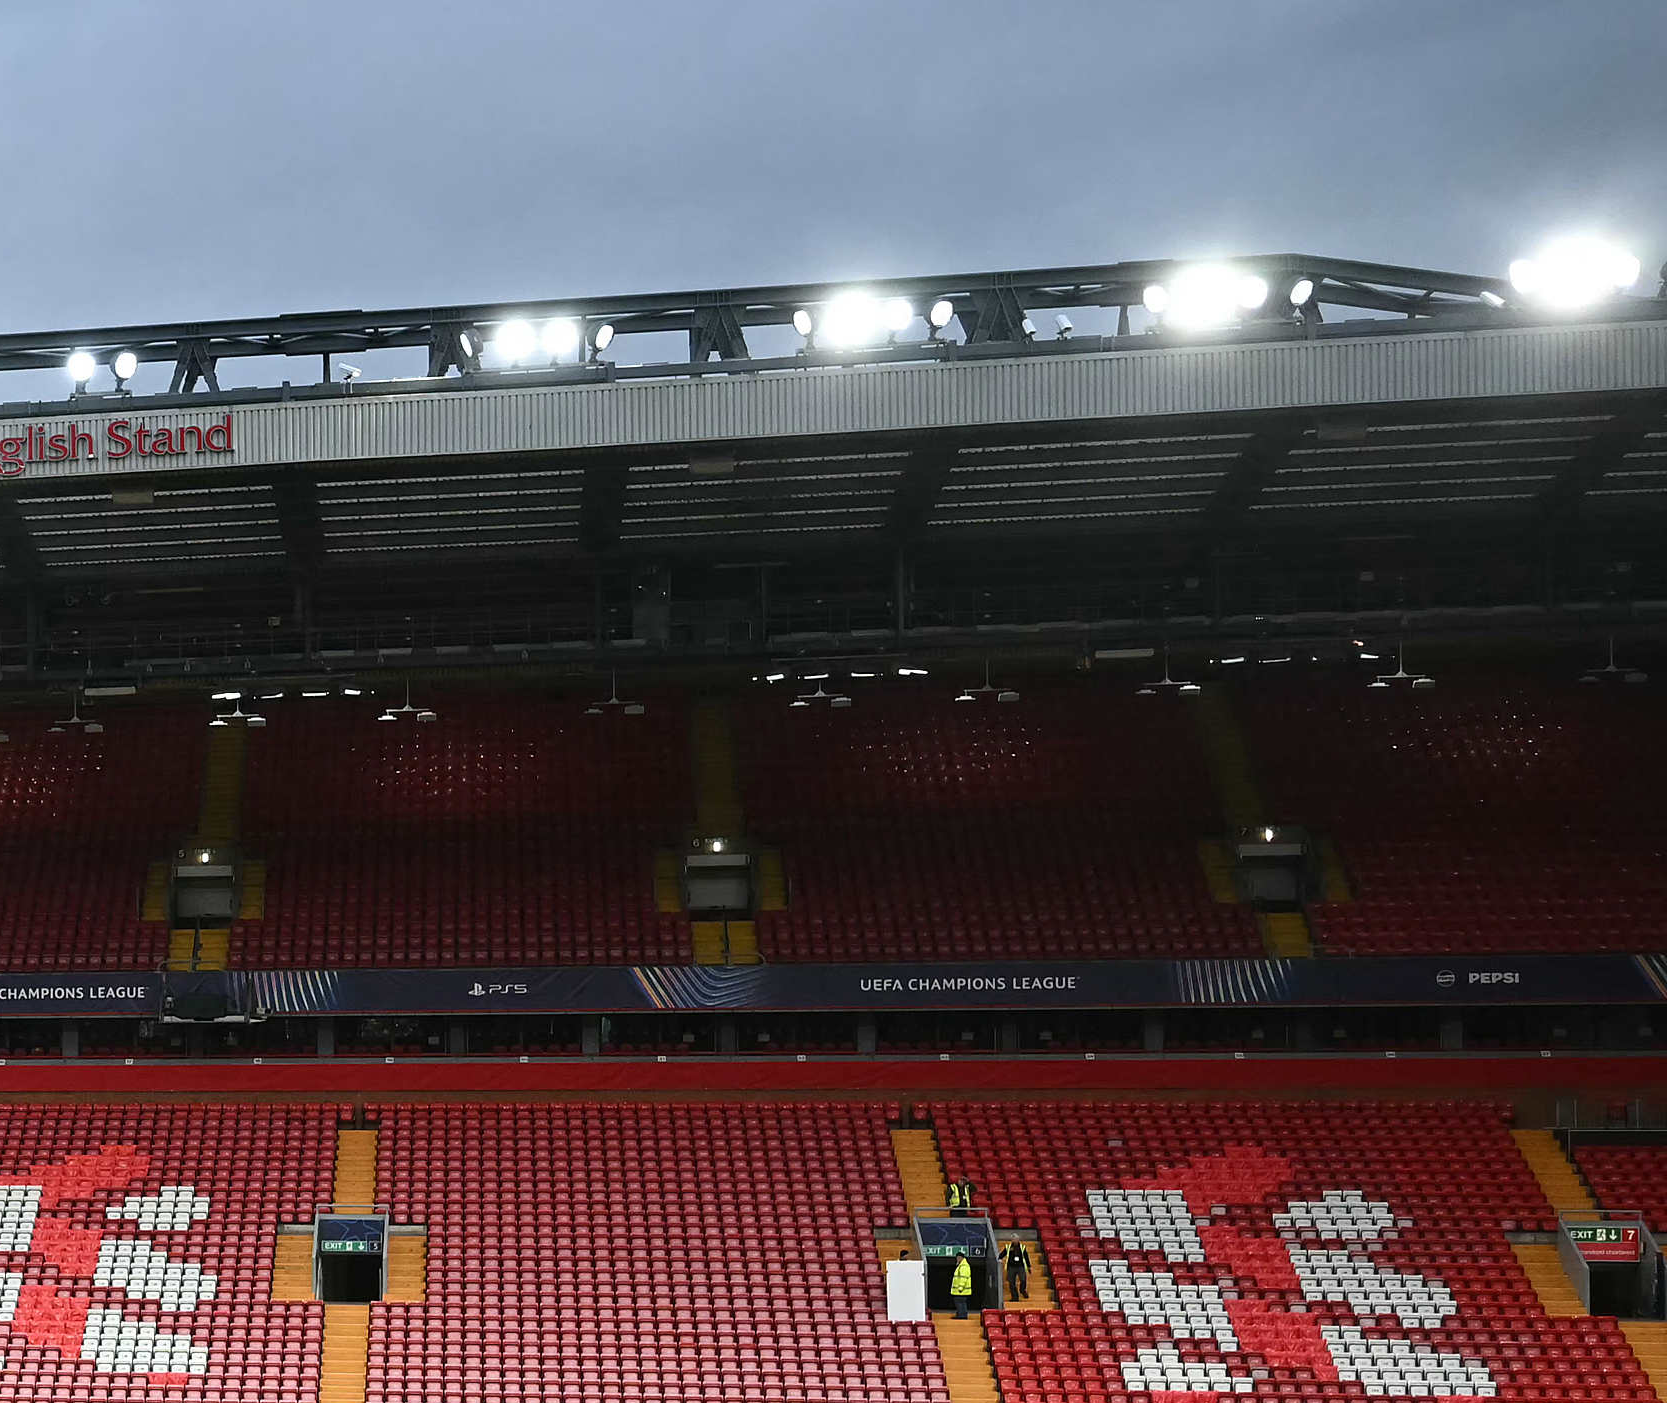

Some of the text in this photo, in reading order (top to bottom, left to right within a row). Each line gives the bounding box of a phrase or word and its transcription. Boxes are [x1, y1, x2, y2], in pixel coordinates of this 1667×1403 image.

[107, 414, 233, 458] Stand
[861, 977, 1076, 990] UEFA CHAMPIONS LEAGUE
[1469, 972, 1519, 984] PEPSI
[0, 988, 84, 999] CHAMPIONS
[90, 986, 145, 998] LEAGUE
[1570, 1230, 1635, 1240] EXIT 7
